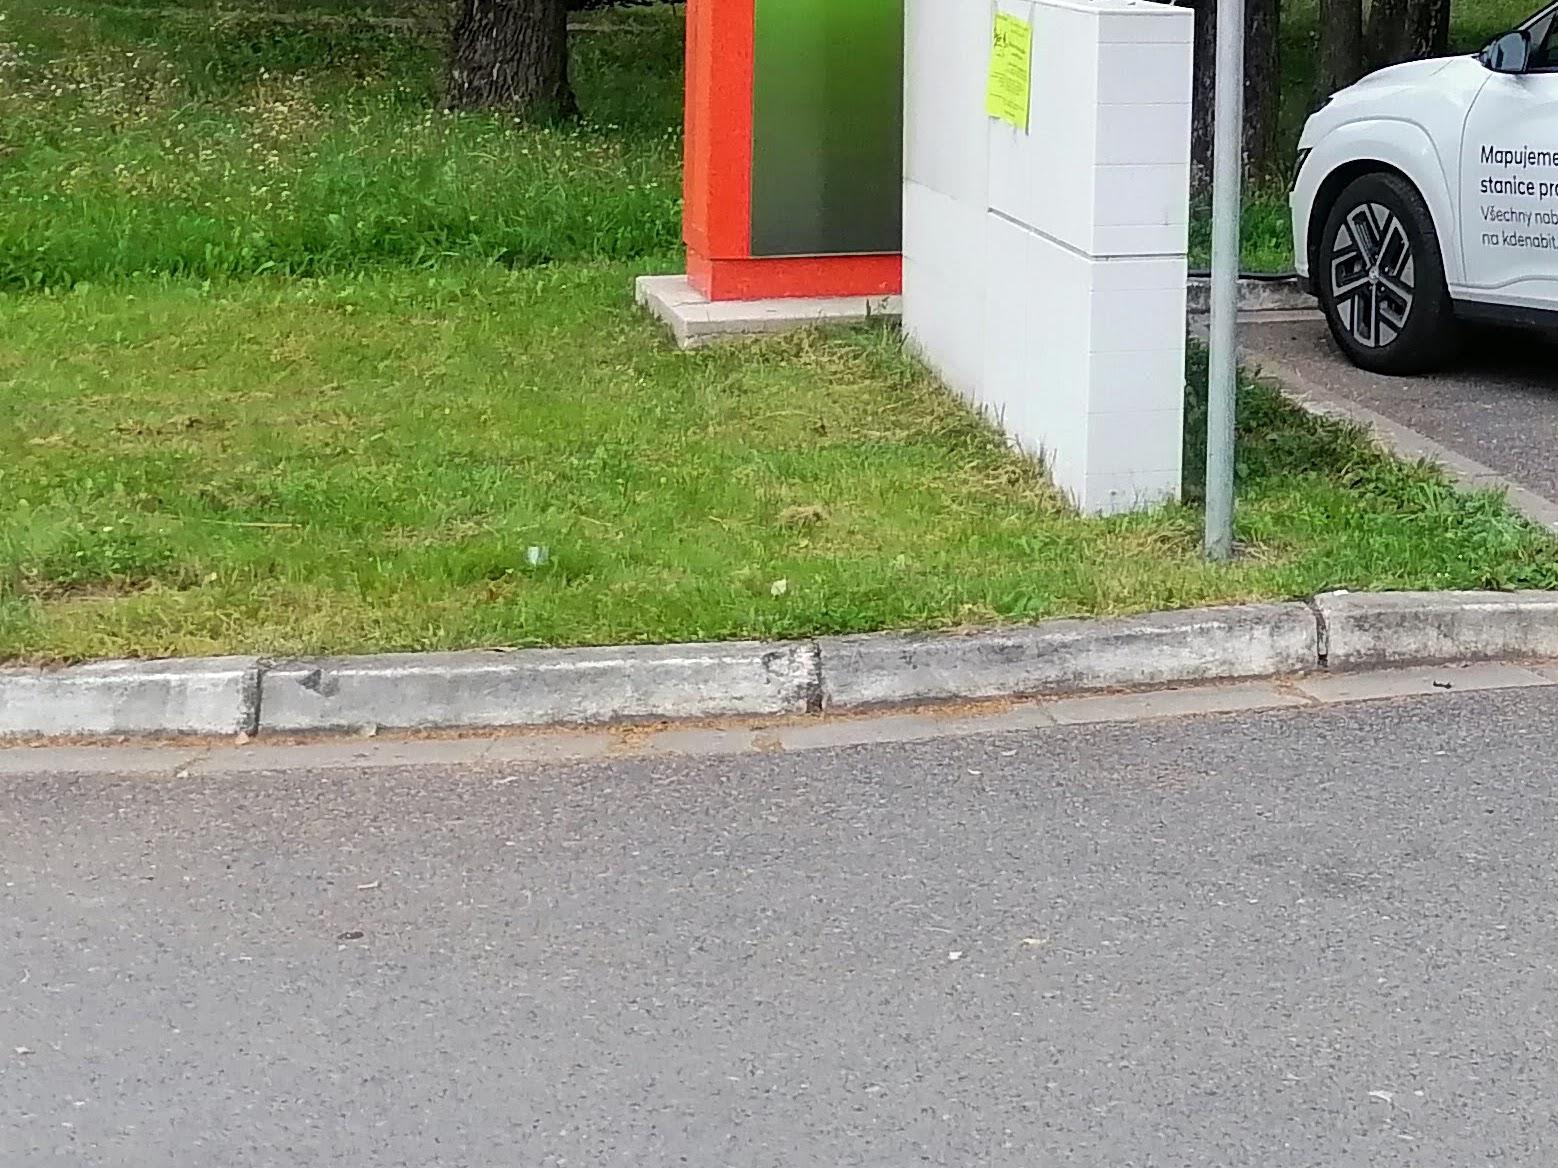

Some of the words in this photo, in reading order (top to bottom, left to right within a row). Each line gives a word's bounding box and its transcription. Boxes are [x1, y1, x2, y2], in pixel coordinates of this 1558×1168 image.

[1480, 175, 1535, 196] stanice
[1480, 205, 1532, 226] Všechny
[1482, 232, 1499, 246] na
